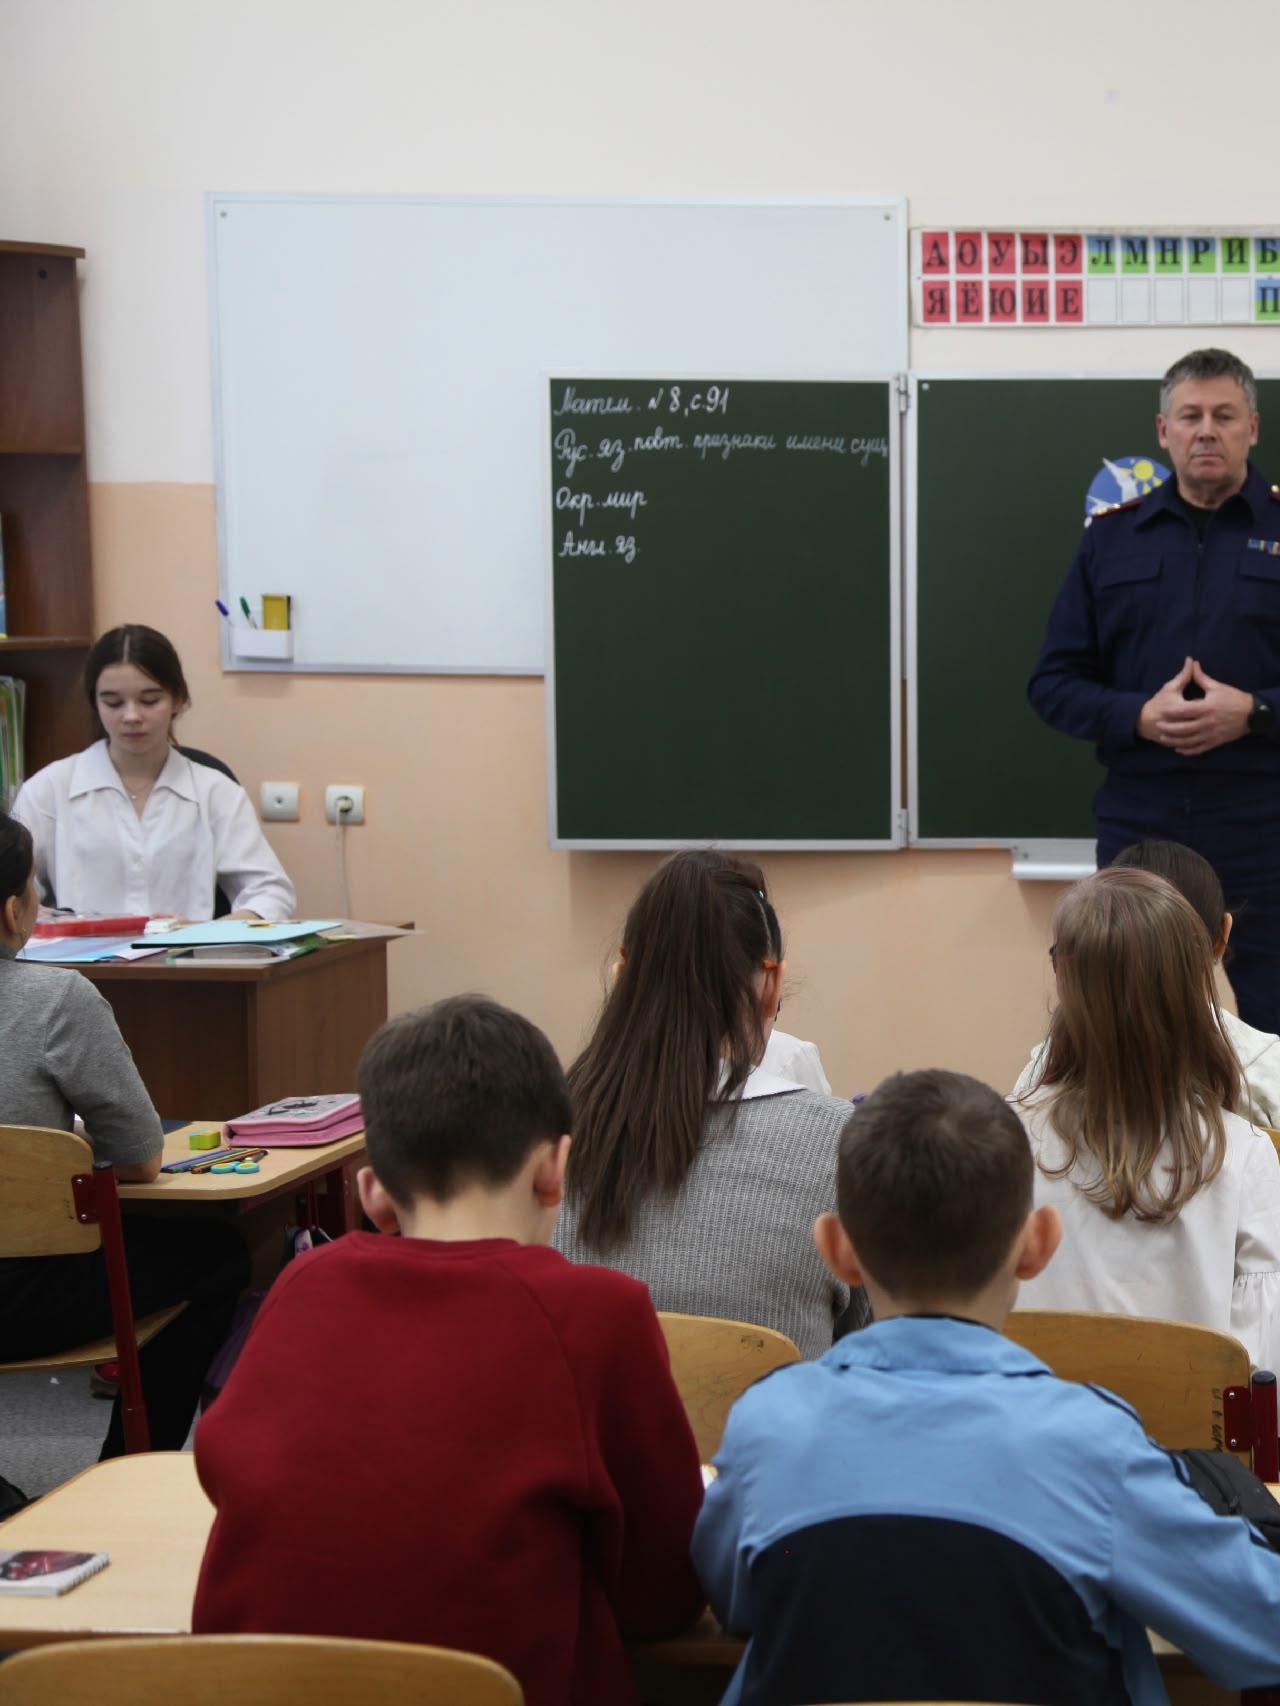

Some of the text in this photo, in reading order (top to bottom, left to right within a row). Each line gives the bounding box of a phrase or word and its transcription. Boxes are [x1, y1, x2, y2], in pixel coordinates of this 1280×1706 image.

[926, 240, 947, 267] А
[957, 239, 978, 266] О
[991, 240, 1012, 266] У
[1022, 238, 1048, 265] Ы
[1059, 239, 1078, 265] Э
[1091, 238, 1114, 265] Л
[1124, 237, 1148, 265] М
[1157, 237, 1181, 265] Н
[1188, 237, 1210, 265] Р
[1257, 237, 1278, 264] Б
[927, 288, 946, 315] Я
[962, 282, 979, 315] Ё
[989, 287, 1017, 315] Ю
[1027, 288, 1046, 315] И
[1062, 288, 1079, 315] Е
[1260, 287, 1280, 313] П
[693, 432, 777, 461] признаки
[786, 434, 846, 455] имени
[602, 489, 649, 520] мир
